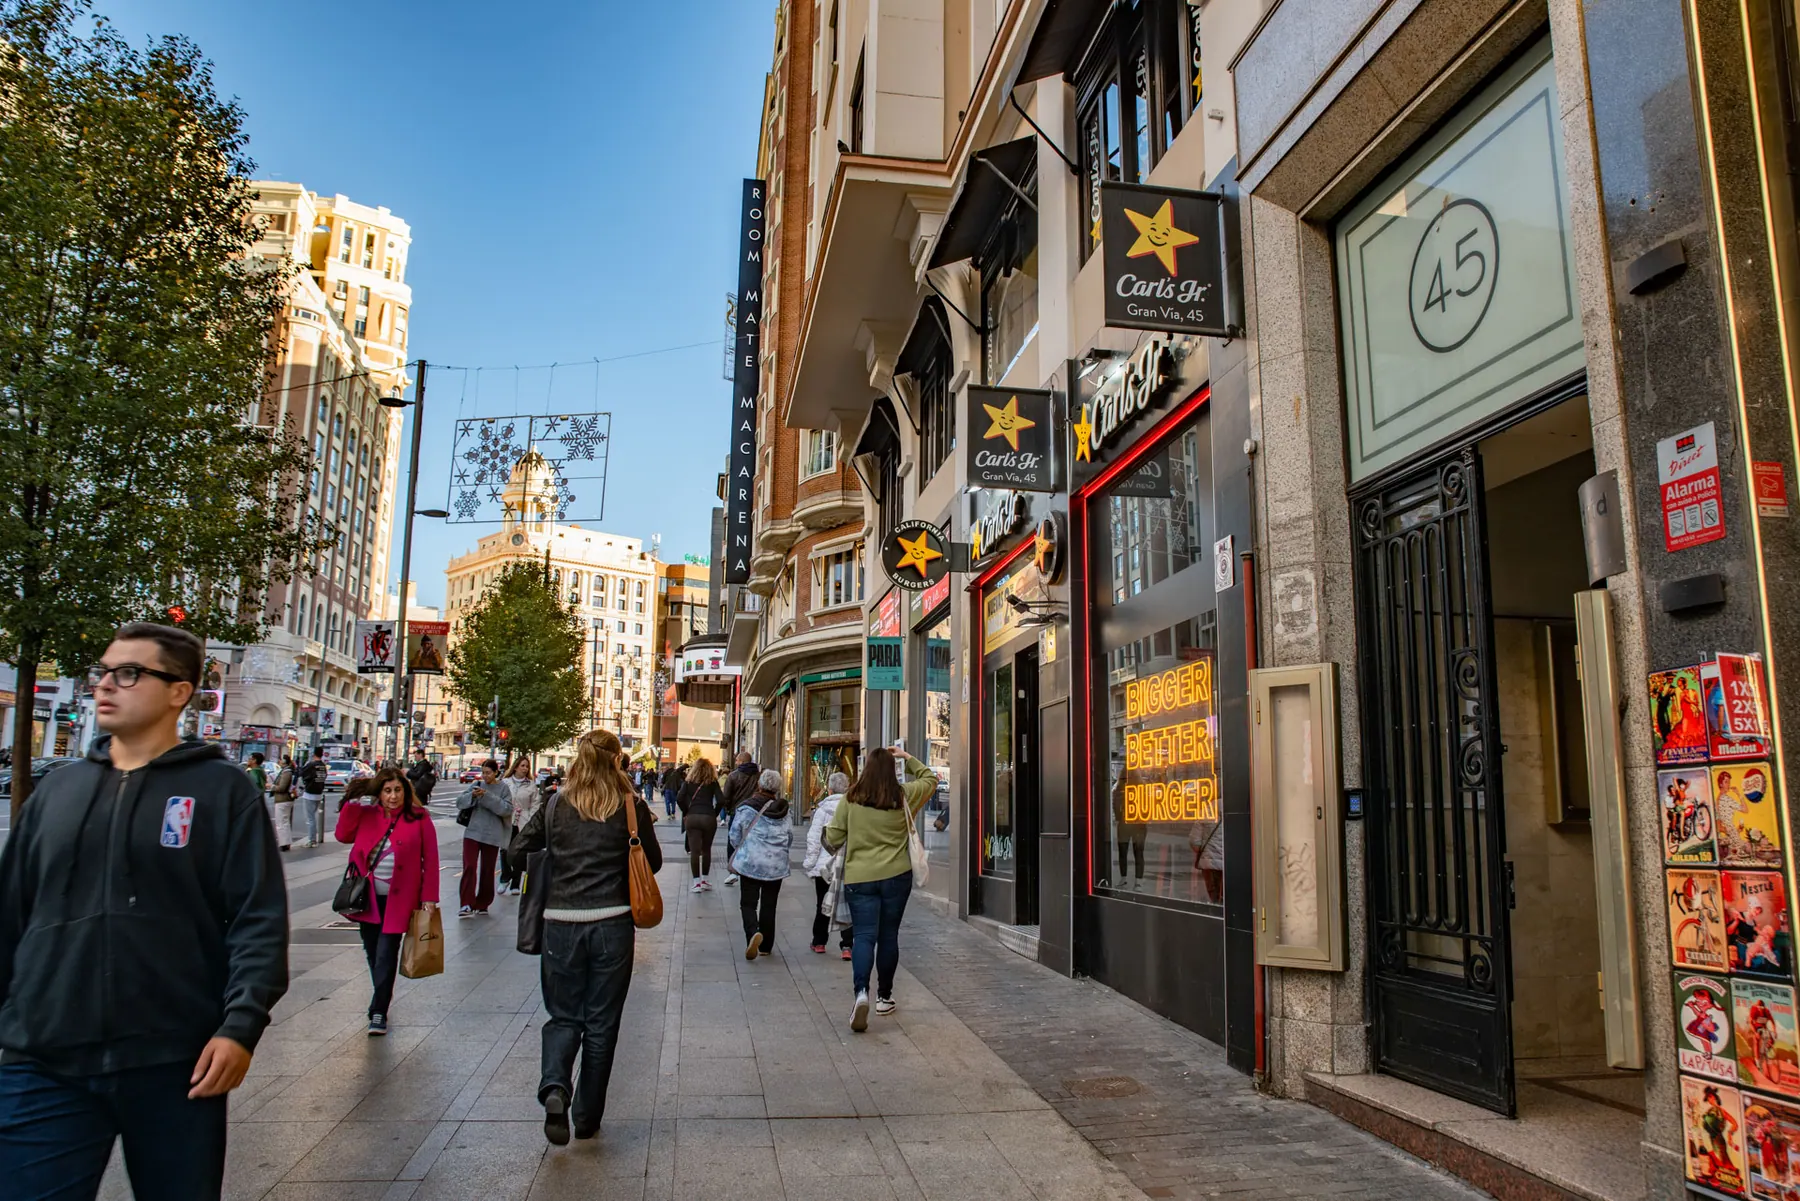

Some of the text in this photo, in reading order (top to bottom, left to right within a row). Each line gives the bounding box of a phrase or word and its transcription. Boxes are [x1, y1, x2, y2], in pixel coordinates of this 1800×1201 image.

[1423, 227, 1486, 313] 45
[1116, 273, 1207, 304] Carl's Jr.
[1127, 303, 1204, 323] Gran Vía, 45
[734, 187, 762, 572] ROOM MATE MACARENA
[1091, 364, 1135, 451] Carl's
[975, 450, 1040, 470] Carl's Jr.
[981, 470, 1037, 483] Gran Vía, 45
[1666, 475, 1716, 501] Alarma
[894, 520, 945, 543] CALIFORNIA
[980, 514, 1004, 555] Carl's
[892, 572, 935, 588] BURGERS
[868, 644, 902, 667] PARA
[1126, 661, 1210, 719] BIGGER
[1126, 719, 1212, 770] BETTER
[1718, 743, 1757, 755] Mahou
[1125, 778, 1217, 821] BURGER
